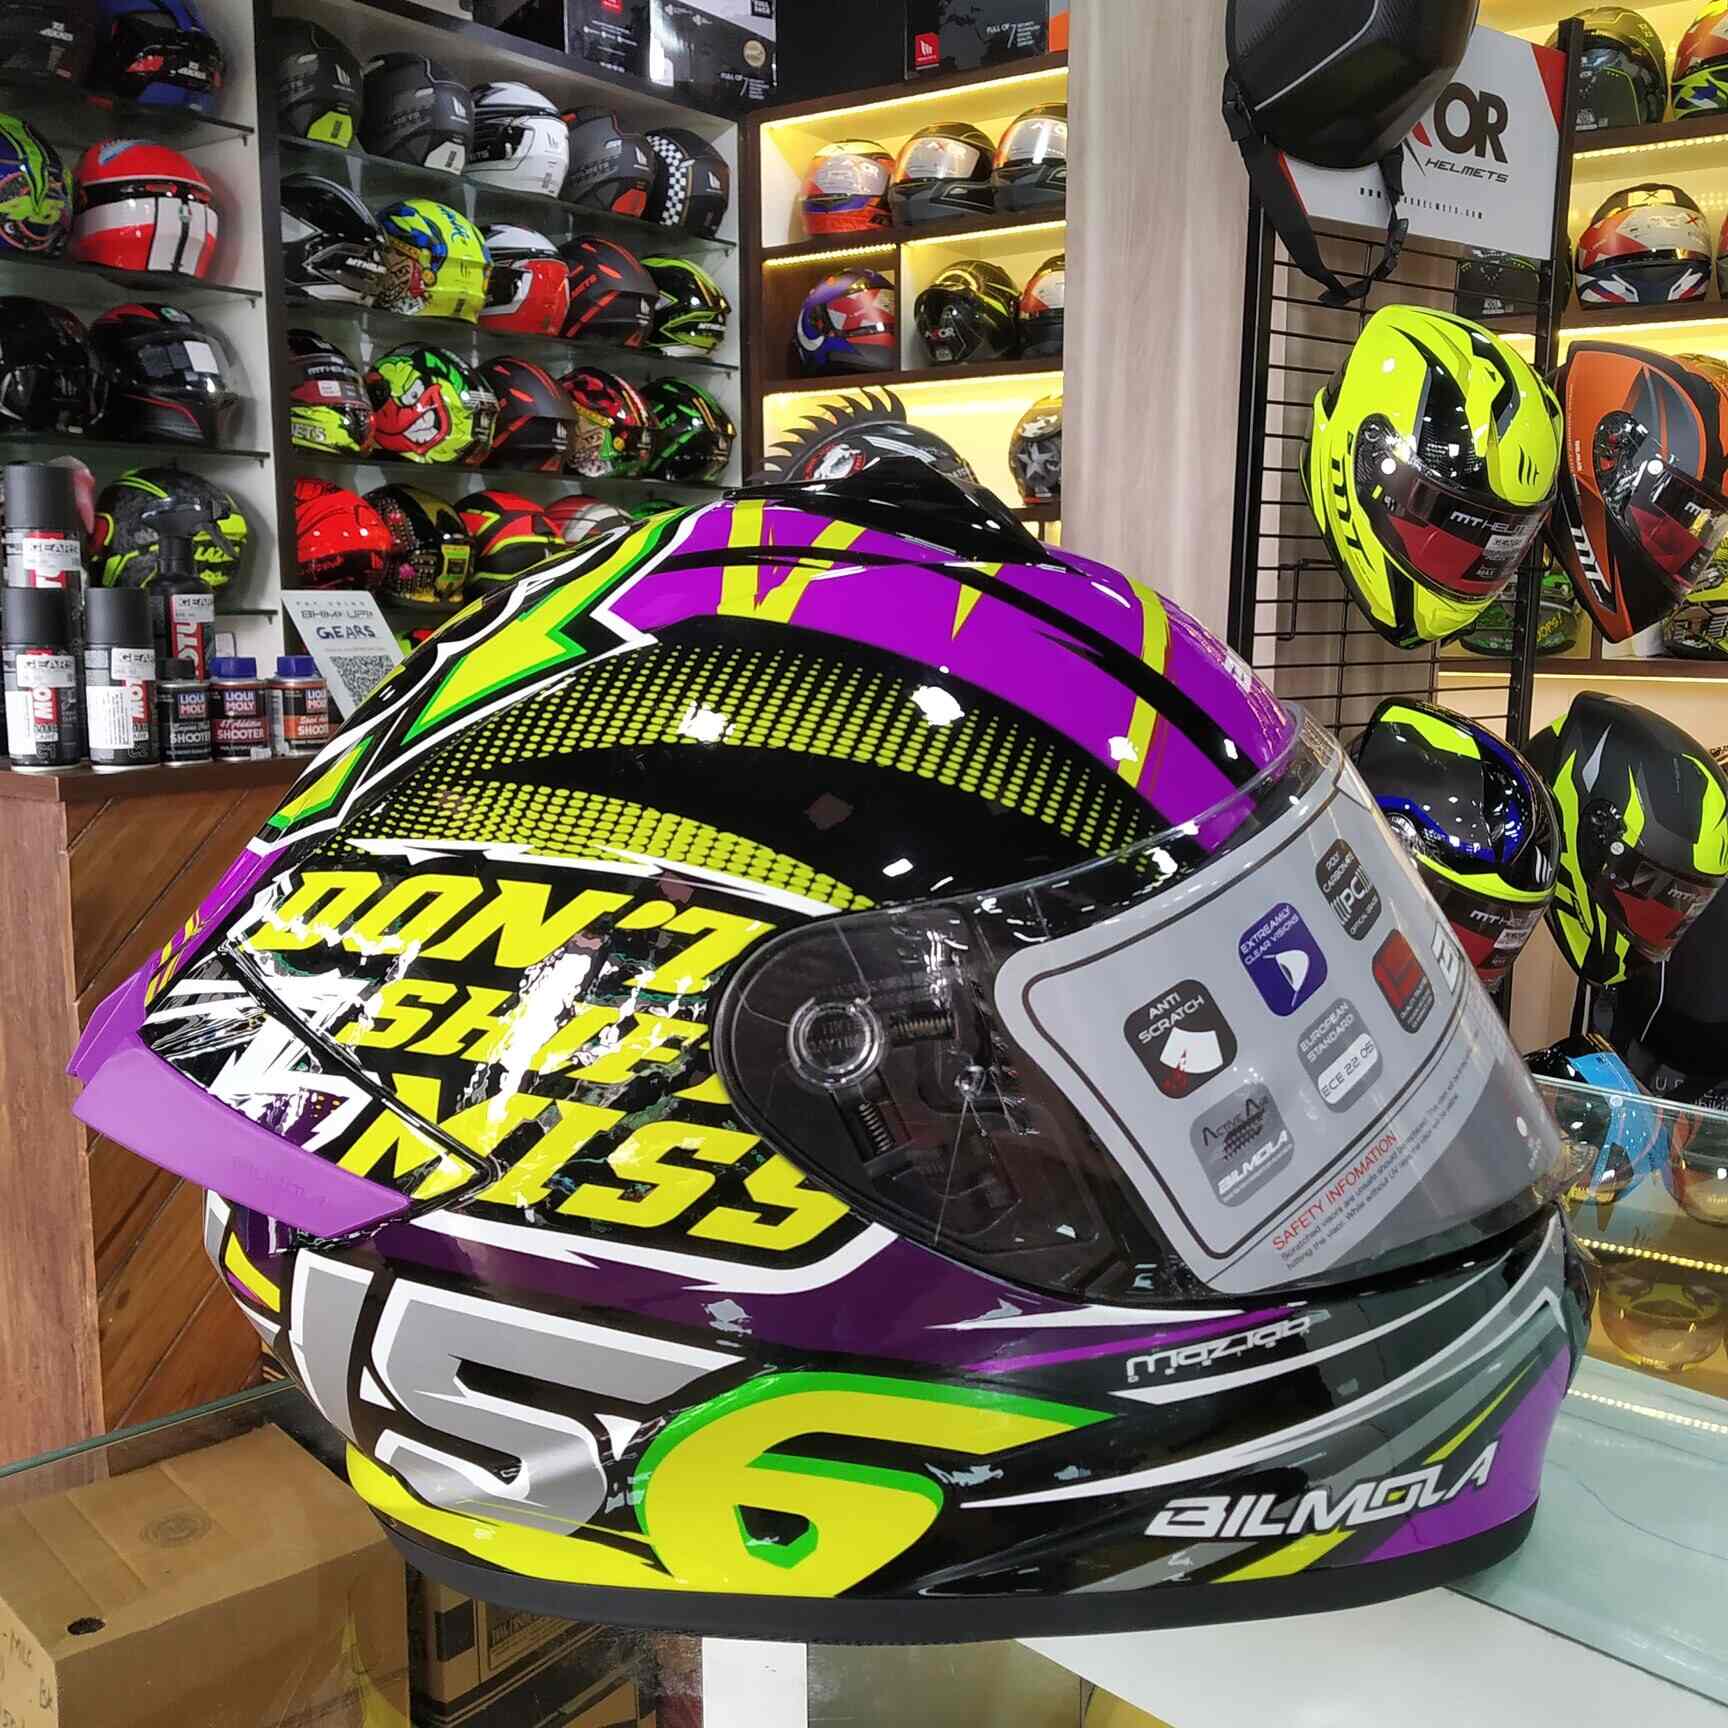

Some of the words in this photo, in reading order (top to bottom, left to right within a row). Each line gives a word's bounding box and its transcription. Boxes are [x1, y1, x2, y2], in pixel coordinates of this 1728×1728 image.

[1425, 158, 1510, 184] HELMETS
[1450, 511, 1483, 526] MT
[316, 624, 377, 640] GEARS
[225, 690, 255, 701] LIQUI
[225, 700, 256, 712] MOLY
[216, 728, 264, 740] SHOOTER
[1243, 939, 1271, 966] CLEAR
[1137, 995, 1205, 1045] SCRATCH
[1148, 992, 1181, 1021] ANTI
[1299, 1002, 1350, 1053] EUROPEAN
[1306, 1013, 1356, 1064] STANDARD
[1321, 1073, 1346, 1099] ECE
[335, 1074, 850, 1251] MISS
[1216, 1129, 1289, 1196] BILMOLA
[1271, 1198, 1325, 1251] SAFETY
[1325, 1129, 1399, 1205] INFOMATION
[1143, 1440, 1500, 1539] BILMOLA
